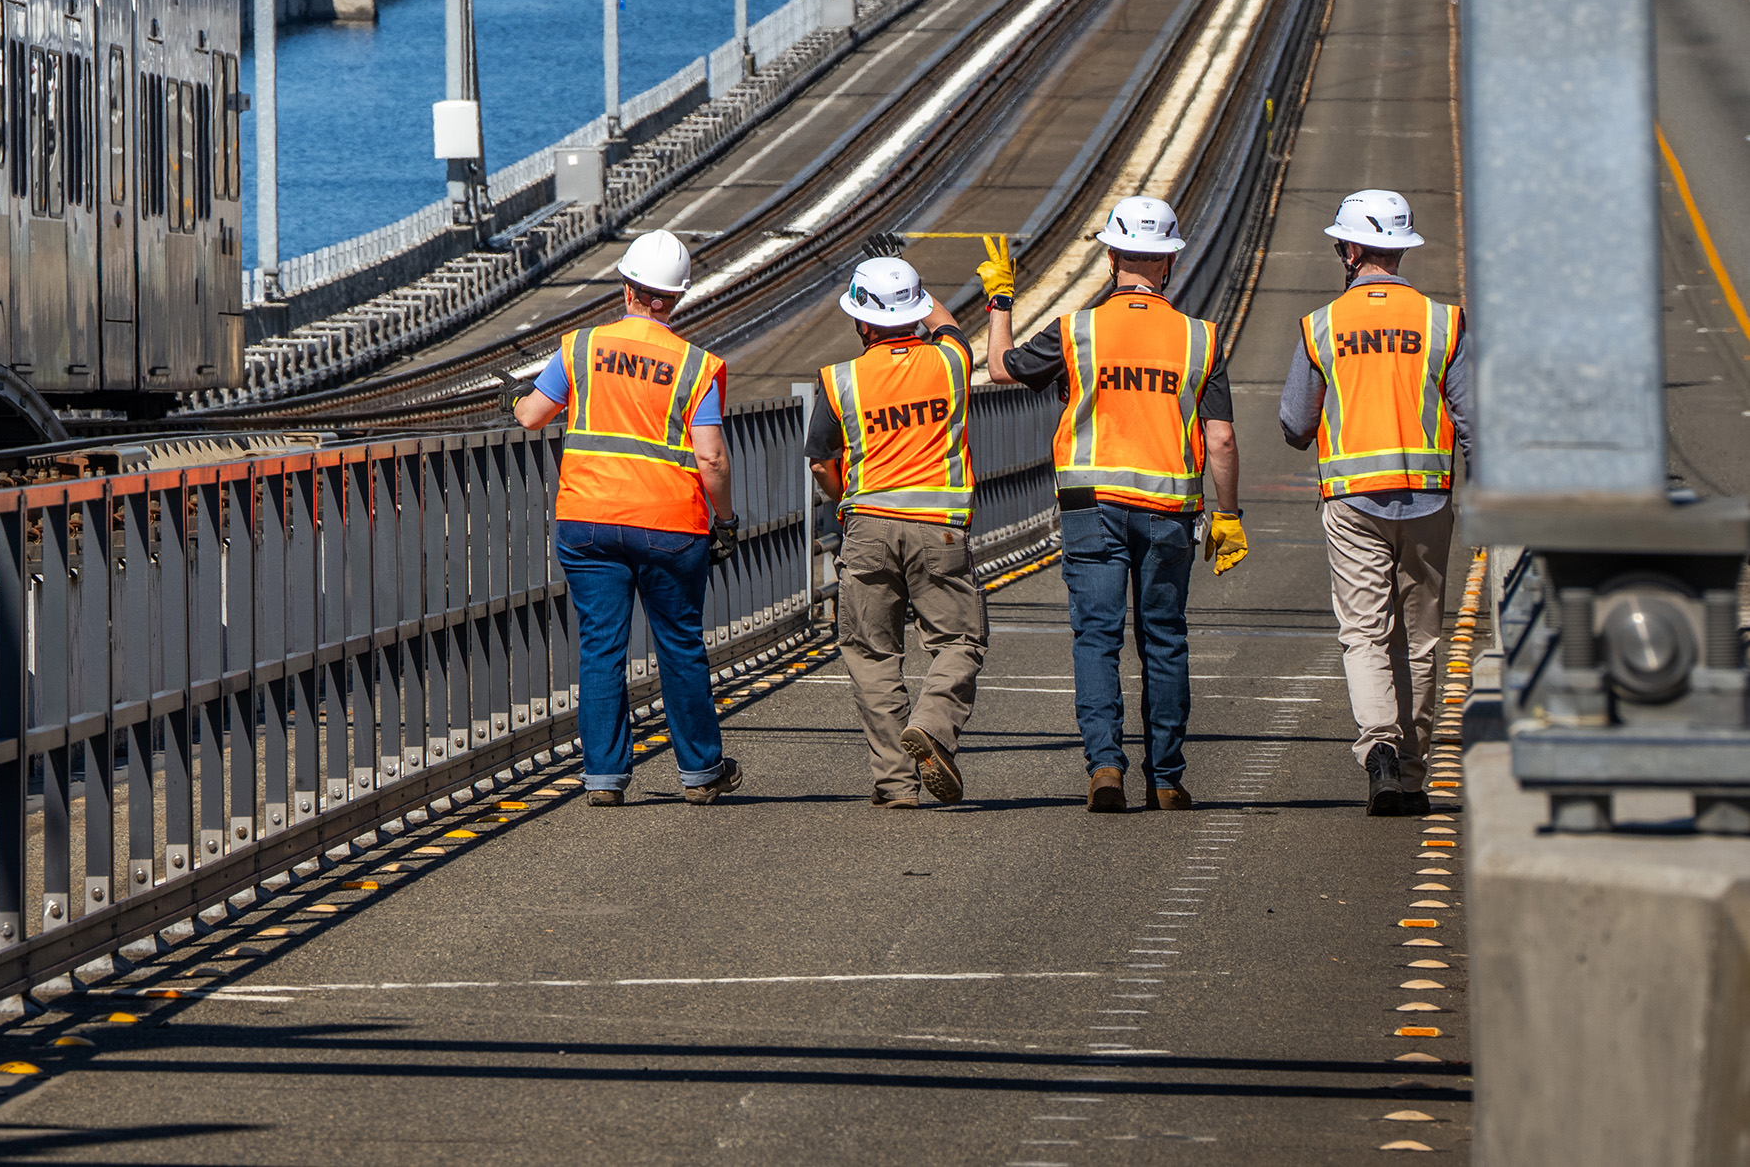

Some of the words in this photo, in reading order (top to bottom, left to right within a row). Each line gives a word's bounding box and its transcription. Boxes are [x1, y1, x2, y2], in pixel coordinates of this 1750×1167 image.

[1336, 328, 1423, 357] HNTB
[595, 347, 675, 386] HNTB
[1099, 366, 1180, 395] HNTB
[864, 397, 949, 434] HNTB
